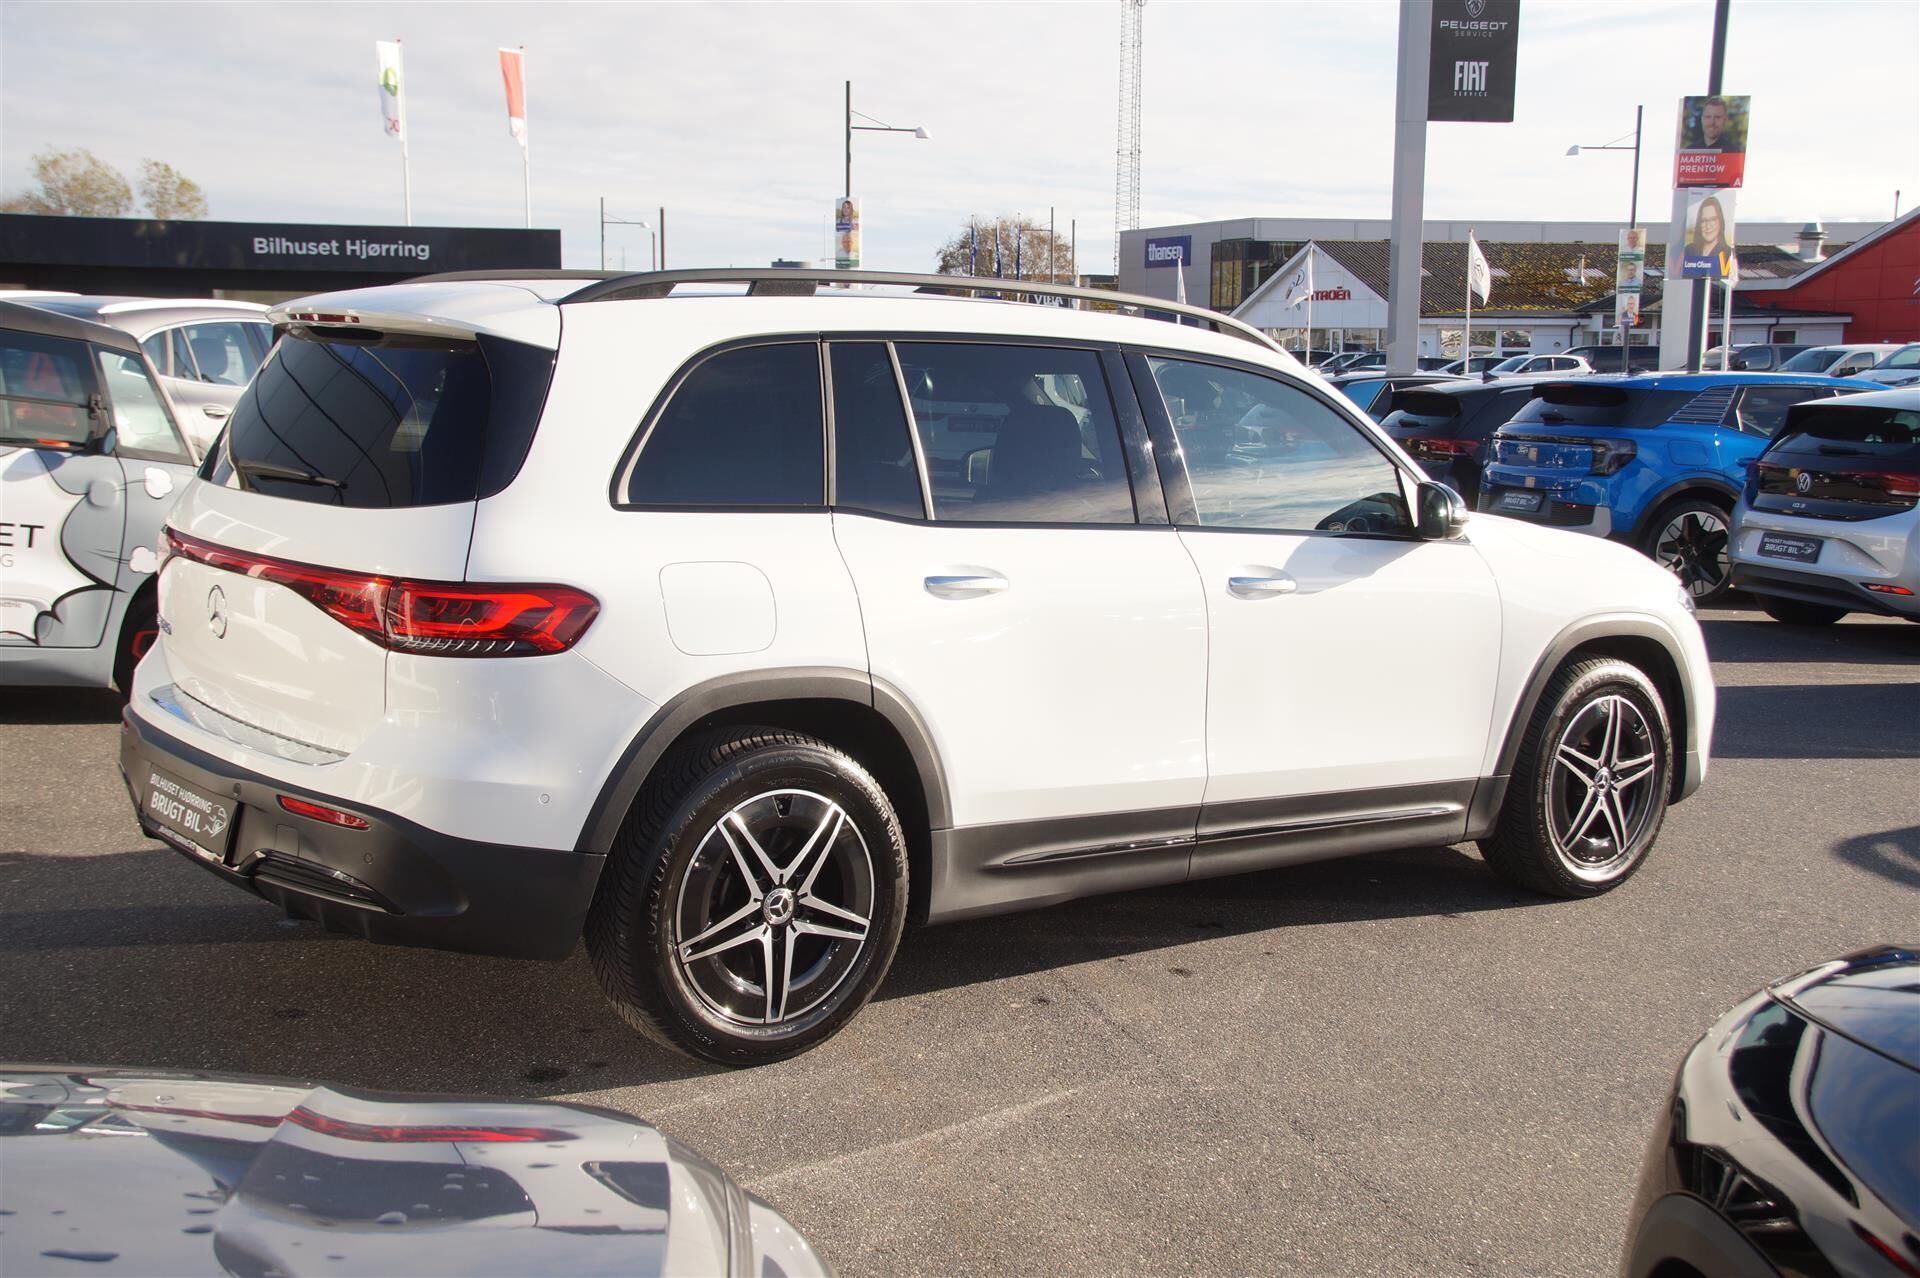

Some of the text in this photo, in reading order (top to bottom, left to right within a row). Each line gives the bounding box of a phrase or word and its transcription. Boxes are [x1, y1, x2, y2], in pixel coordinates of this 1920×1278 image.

[1440, 20, 1508, 30] PEUGEOT
[1454, 30, 1492, 38] SERVICE
[1454, 61, 1489, 91] FIAT
[1680, 155, 1716, 164] MARTIN
[1680, 165, 1725, 173] PRENTOW
[253, 238, 430, 261] Bilhuset Hjørring
[1148, 243, 1183, 262] thansen
[1304, 285, 1351, 301] ITROËN
[1764, 543, 1786, 552] BRUGT
[150, 773, 212, 813] BILHUSET HJØRRING
[150, 791, 201, 832] BRUGT BIL
